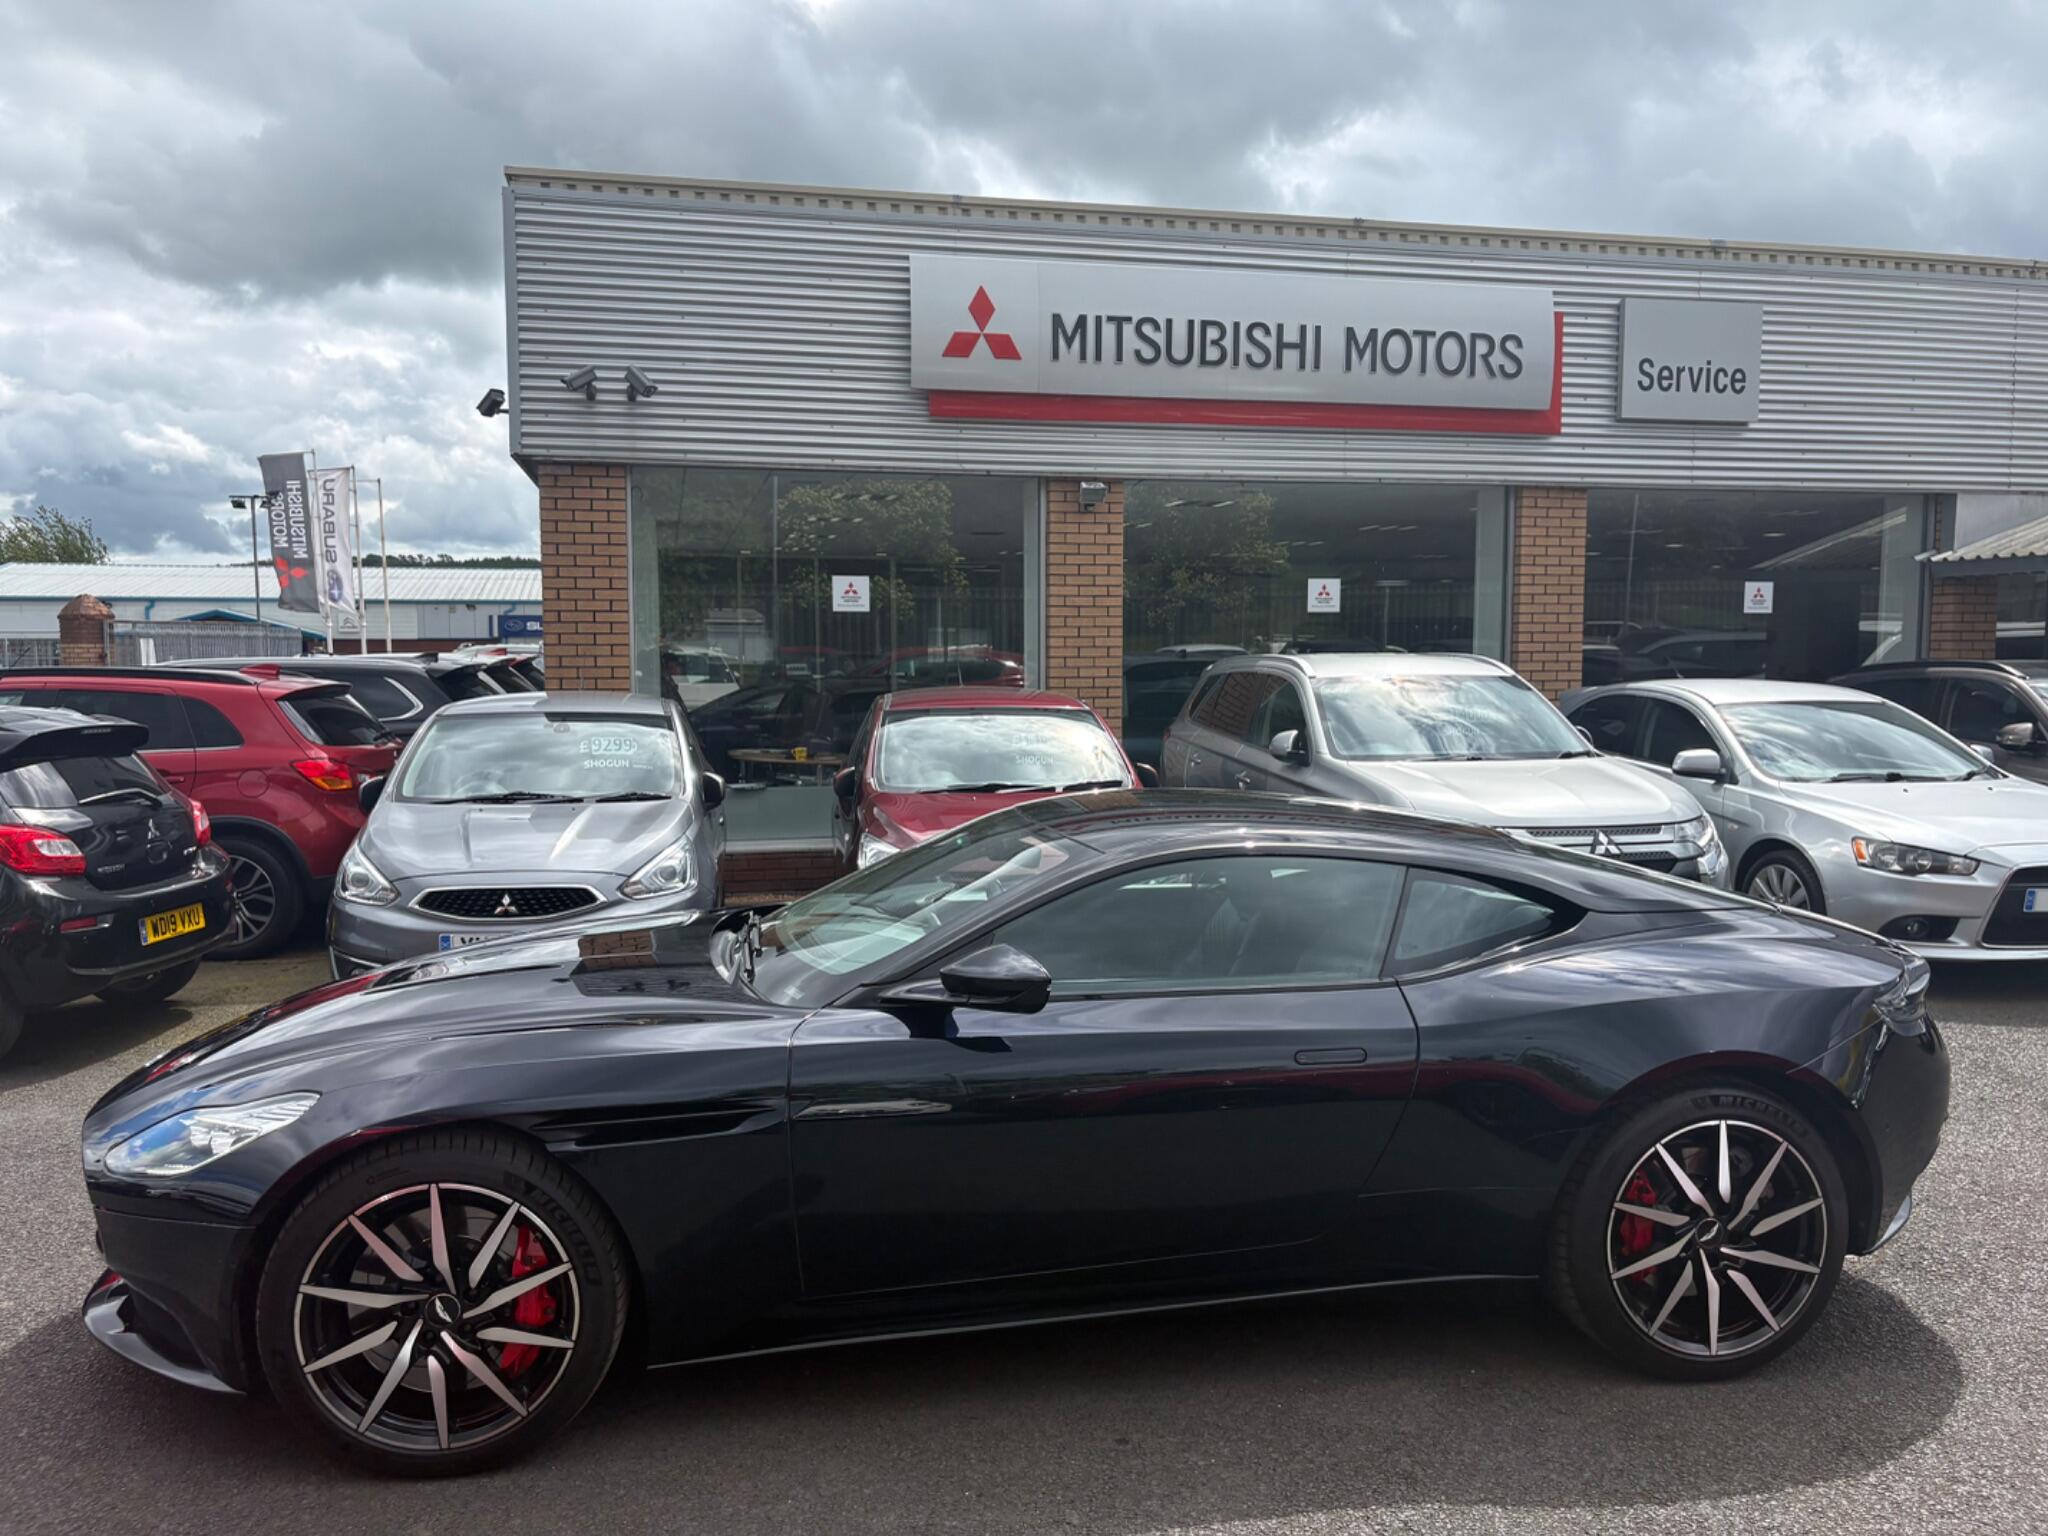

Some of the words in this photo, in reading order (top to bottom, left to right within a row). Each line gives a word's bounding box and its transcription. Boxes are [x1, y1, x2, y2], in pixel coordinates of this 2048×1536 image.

[1052, 313, 1321, 370] MITSUBISHI
[1344, 326, 1524, 379] MOTORS
[1637, 357, 1747, 395] Service
[583, 759, 630, 769] SHOGUN
[179, 906, 200, 930] VXU
